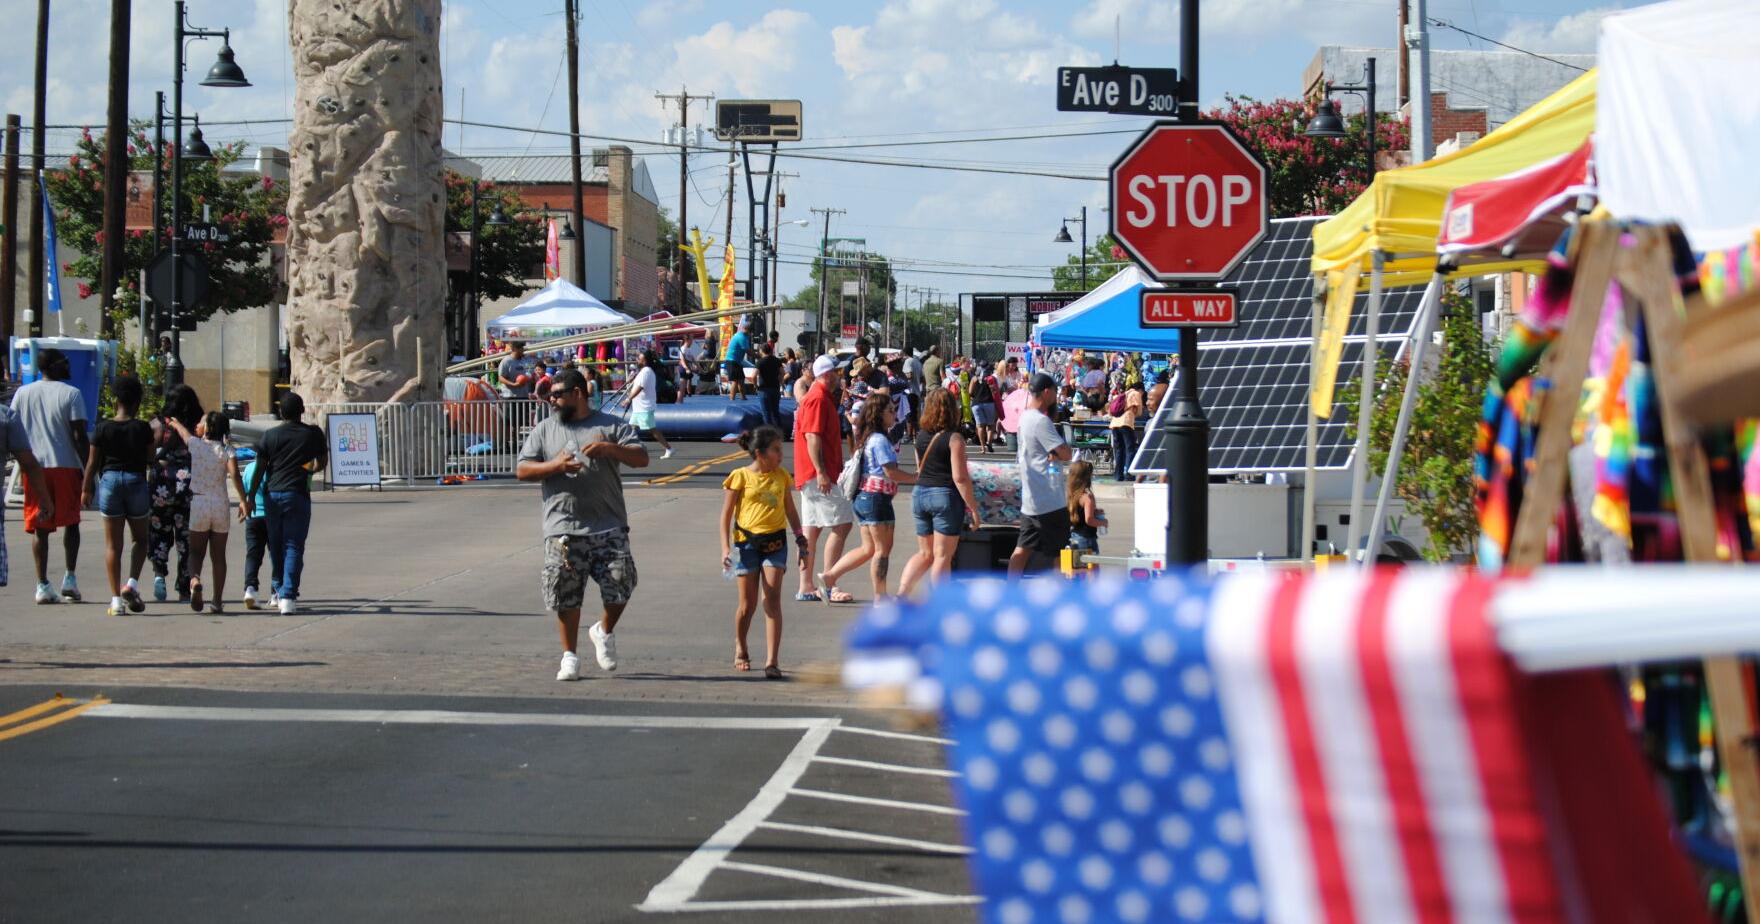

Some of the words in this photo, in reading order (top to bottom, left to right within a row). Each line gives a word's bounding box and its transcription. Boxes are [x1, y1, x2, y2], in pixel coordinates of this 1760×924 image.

[1062, 70, 1071, 87] E
[1072, 73, 1120, 106] Ave
[1130, 74, 1147, 106] D
[1148, 94, 1174, 111] 300
[1126, 174, 1252, 228] STOP
[187, 226, 207, 240] Ave
[210, 226, 218, 240] D
[1151, 300, 1183, 317] ALL
[1192, 300, 1226, 317] WAY
[502, 328, 537, 338] FACE
